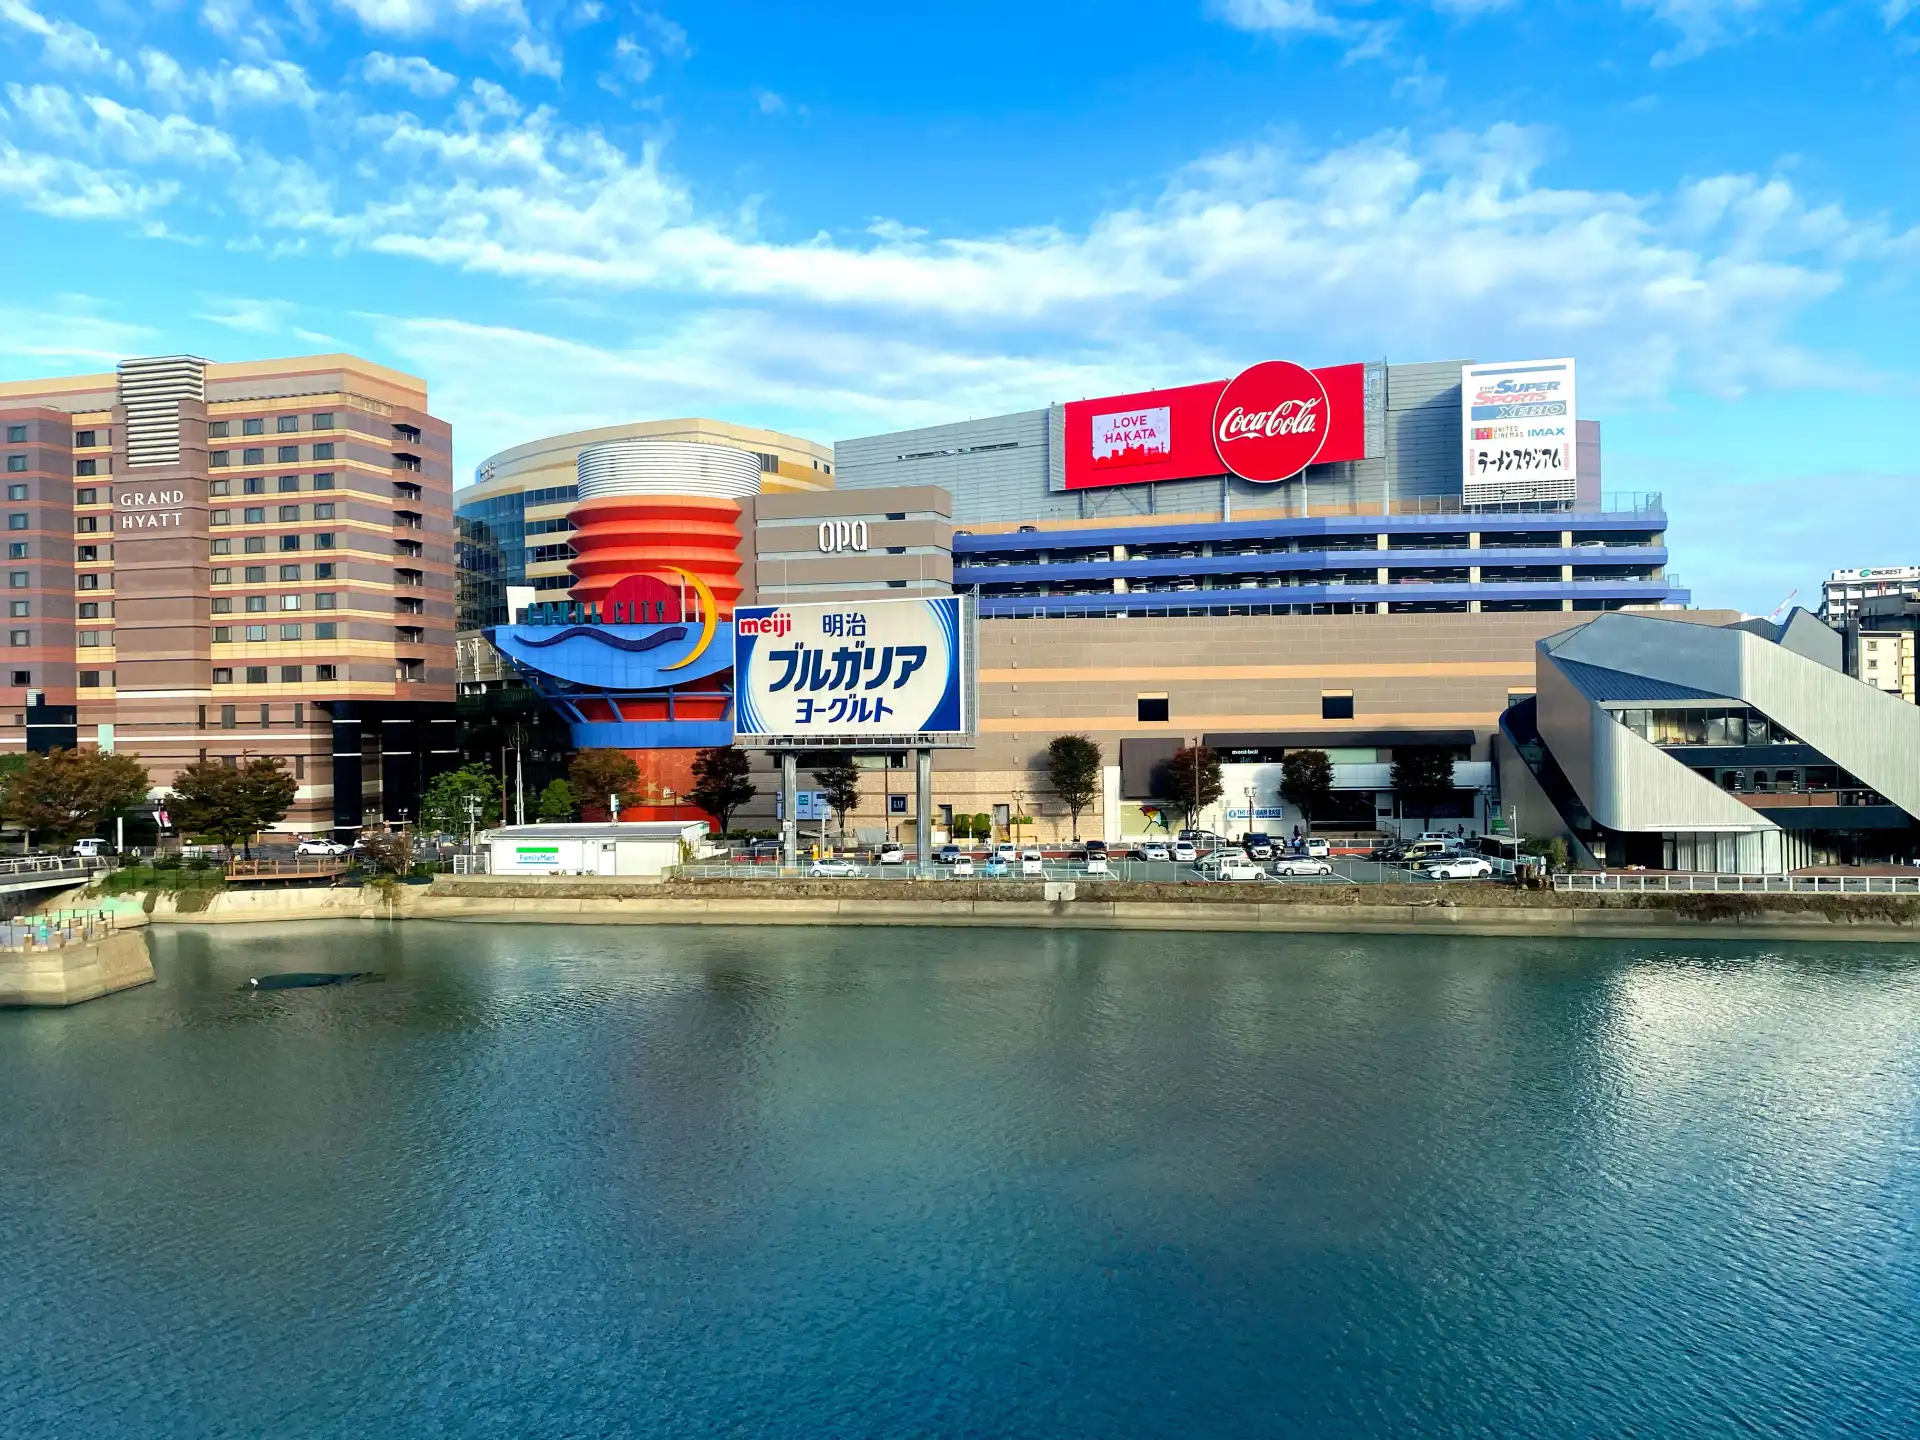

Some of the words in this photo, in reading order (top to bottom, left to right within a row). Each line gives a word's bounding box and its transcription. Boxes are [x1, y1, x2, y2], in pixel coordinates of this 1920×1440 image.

[1495, 380, 1561, 394] SUPER
[1473, 391, 1548, 405] SPORTS
[1496, 403, 1564, 419] XEBIO
[1113, 415, 1147, 429] LOVE
[1220, 397, 1322, 442] Coca-Cola
[1104, 428, 1156, 443] HAKATA
[1528, 427, 1565, 437] IMAX
[1478, 448, 1561, 473] ラーメンスタジアム
[120, 490, 184, 506] GRAND
[122, 512, 183, 529] HYATT
[527, 602, 601, 626] CANAL
[614, 601, 665, 624] CITY
[739, 612, 792, 638] meiji
[822, 612, 867, 638] 明治
[768, 640, 928, 693] ブルガリア
[794, 693, 894, 724] ヨーグルト
[519, 854, 556, 862] FamilyMart
